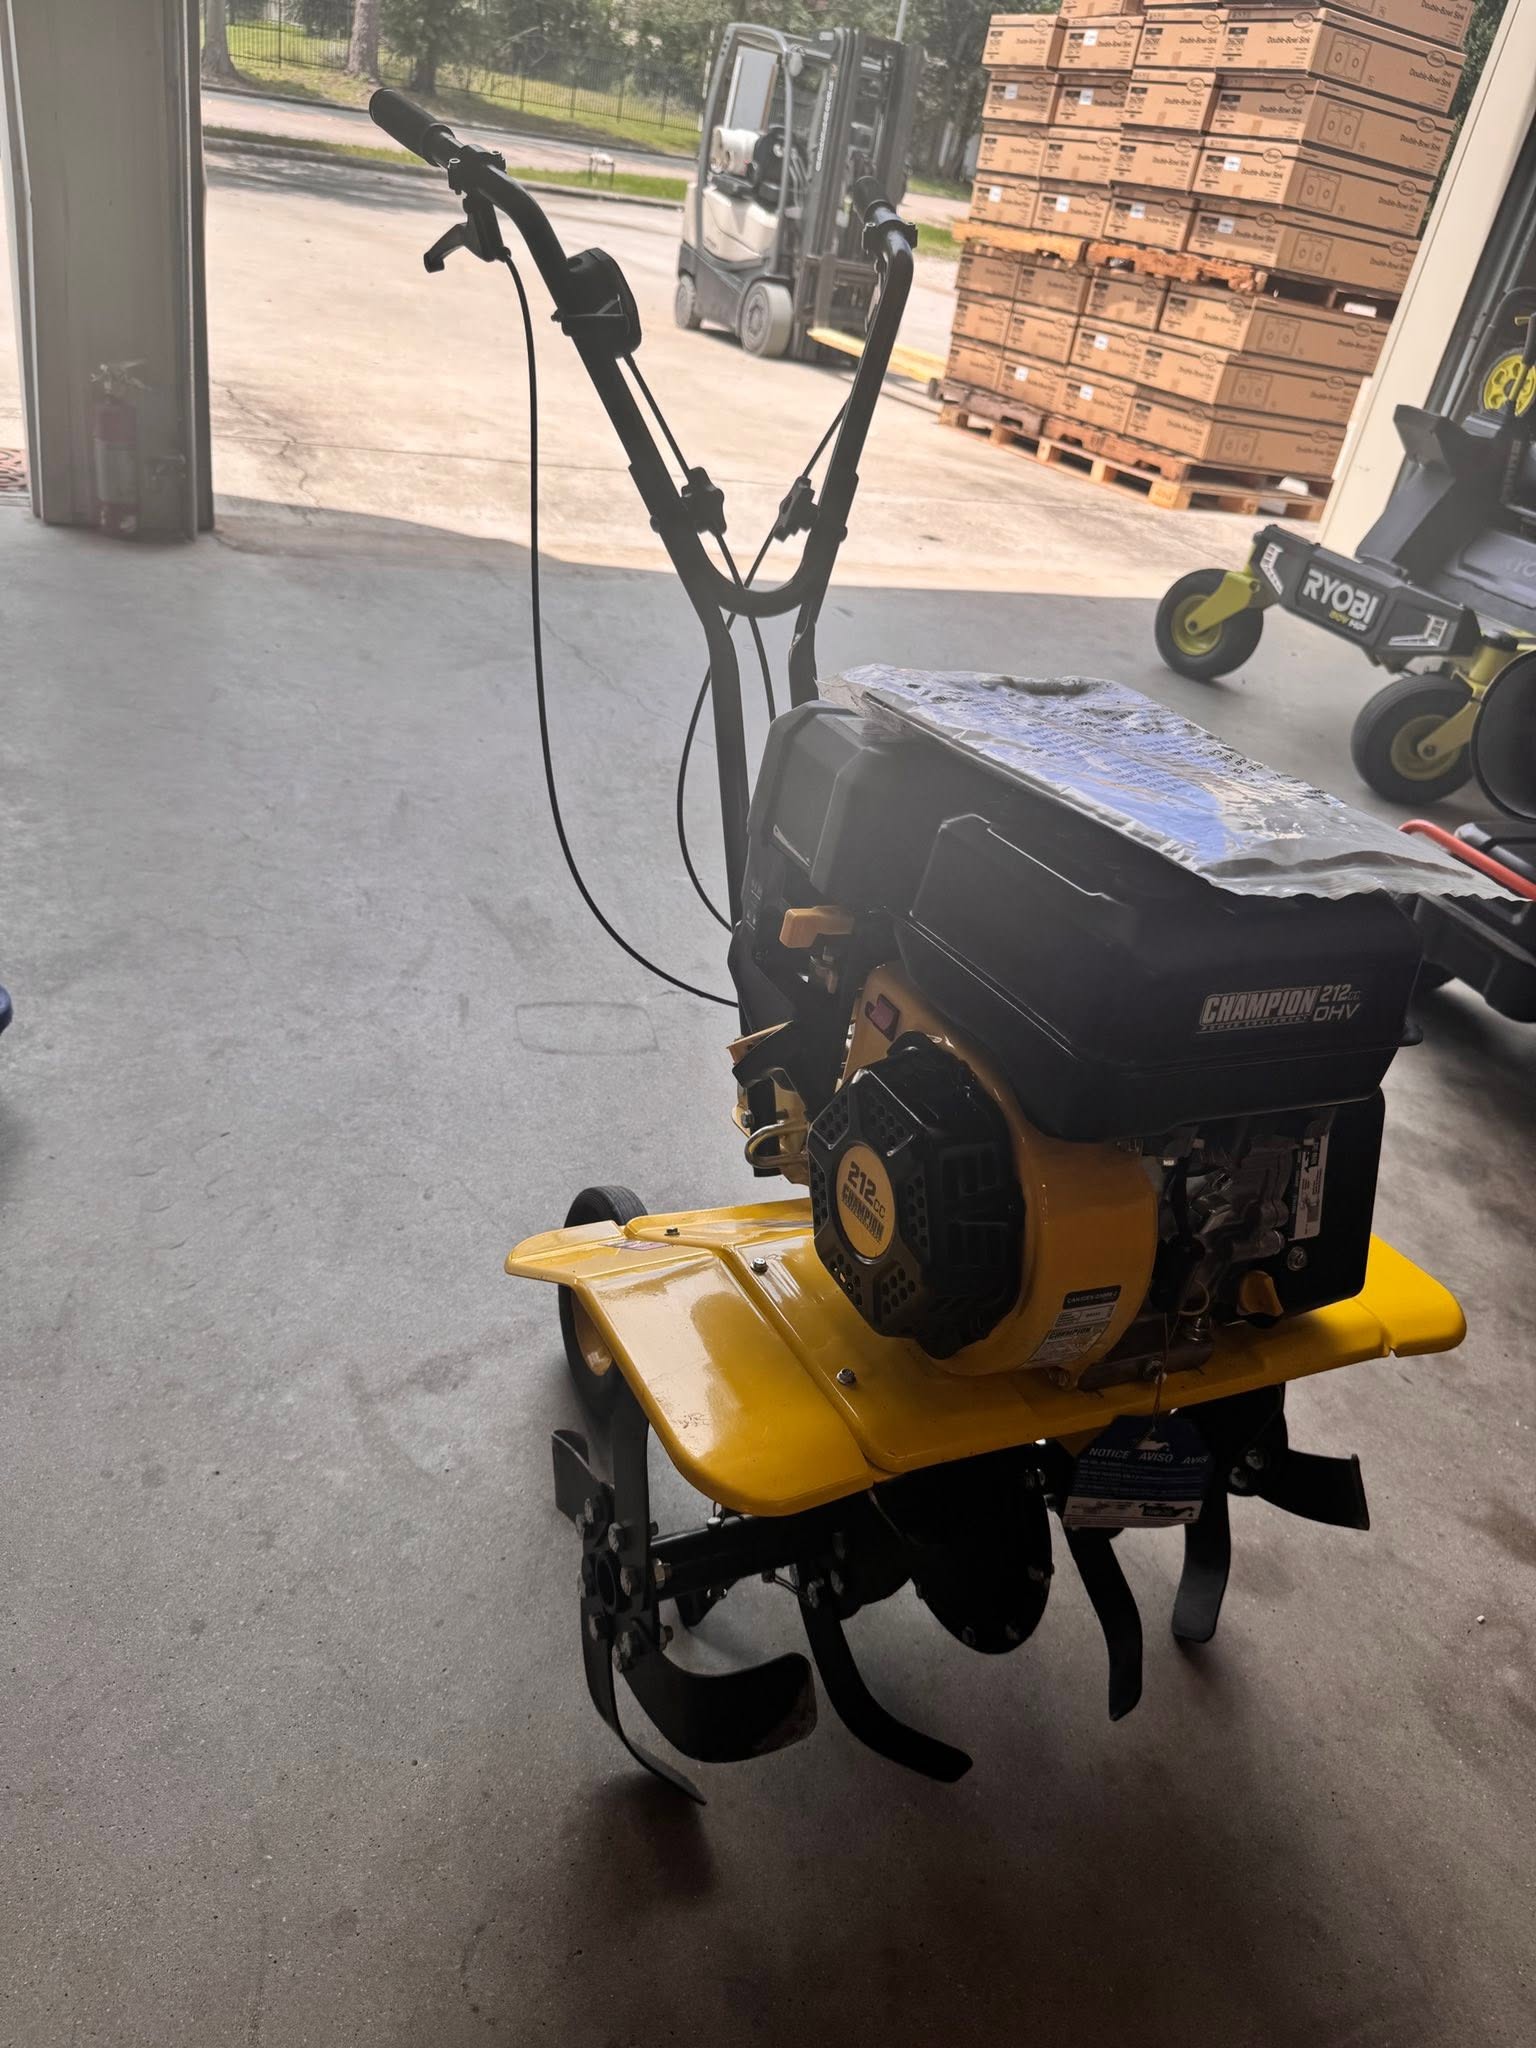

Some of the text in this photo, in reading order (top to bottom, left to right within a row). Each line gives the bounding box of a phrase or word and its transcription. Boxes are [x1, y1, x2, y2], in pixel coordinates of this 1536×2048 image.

[1302, 568, 1378, 624] RYOBI
[1201, 987, 1317, 1024] CHAMPION
[1312, 1003, 1361, 1022] OHV
[840, 1182, 885, 1243] CHAMPION
[1089, 1447, 1209, 1465] NOTICE AVISO AVIS
